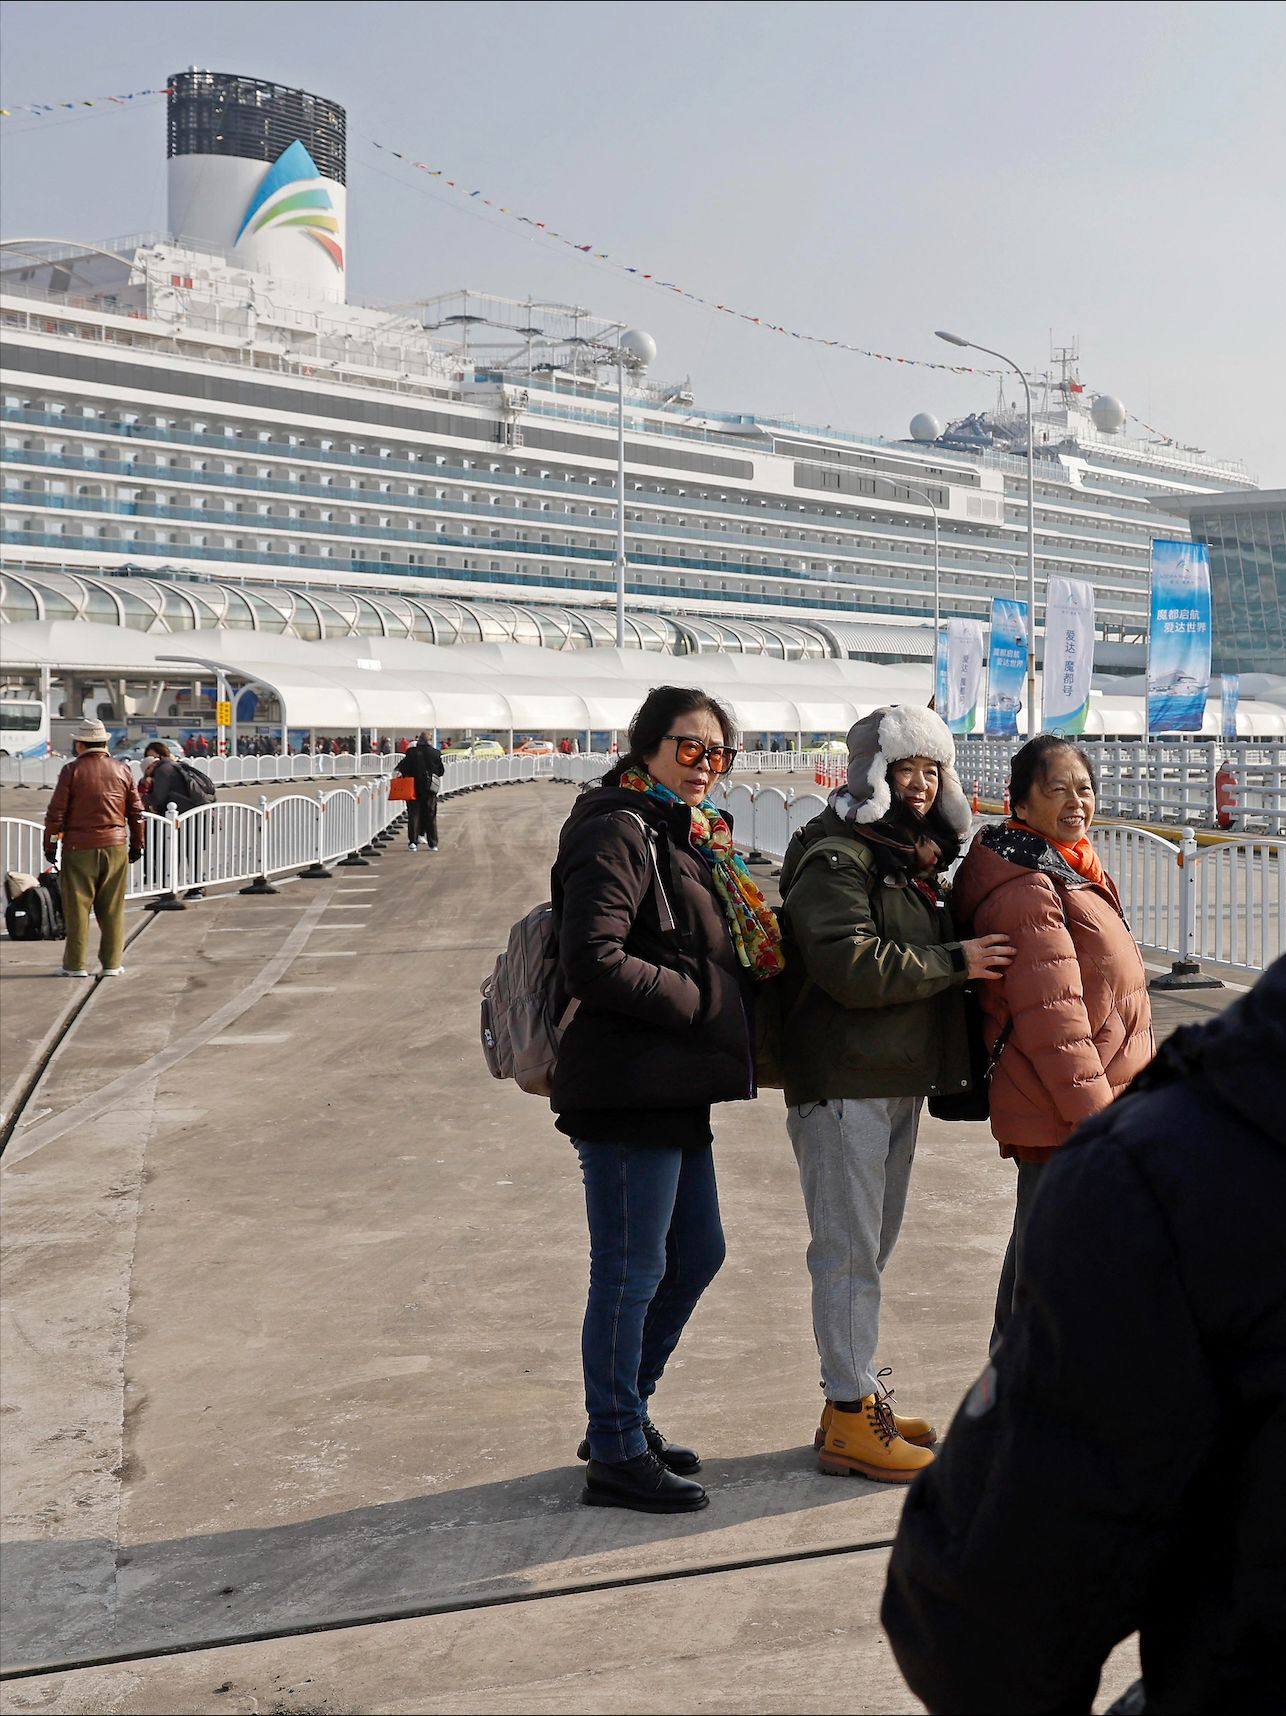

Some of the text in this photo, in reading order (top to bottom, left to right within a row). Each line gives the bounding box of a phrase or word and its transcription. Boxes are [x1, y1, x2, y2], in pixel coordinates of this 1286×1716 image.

[1156, 608, 1200, 621] 魔都启航
[1163, 622, 1207, 633] 爱达世界
